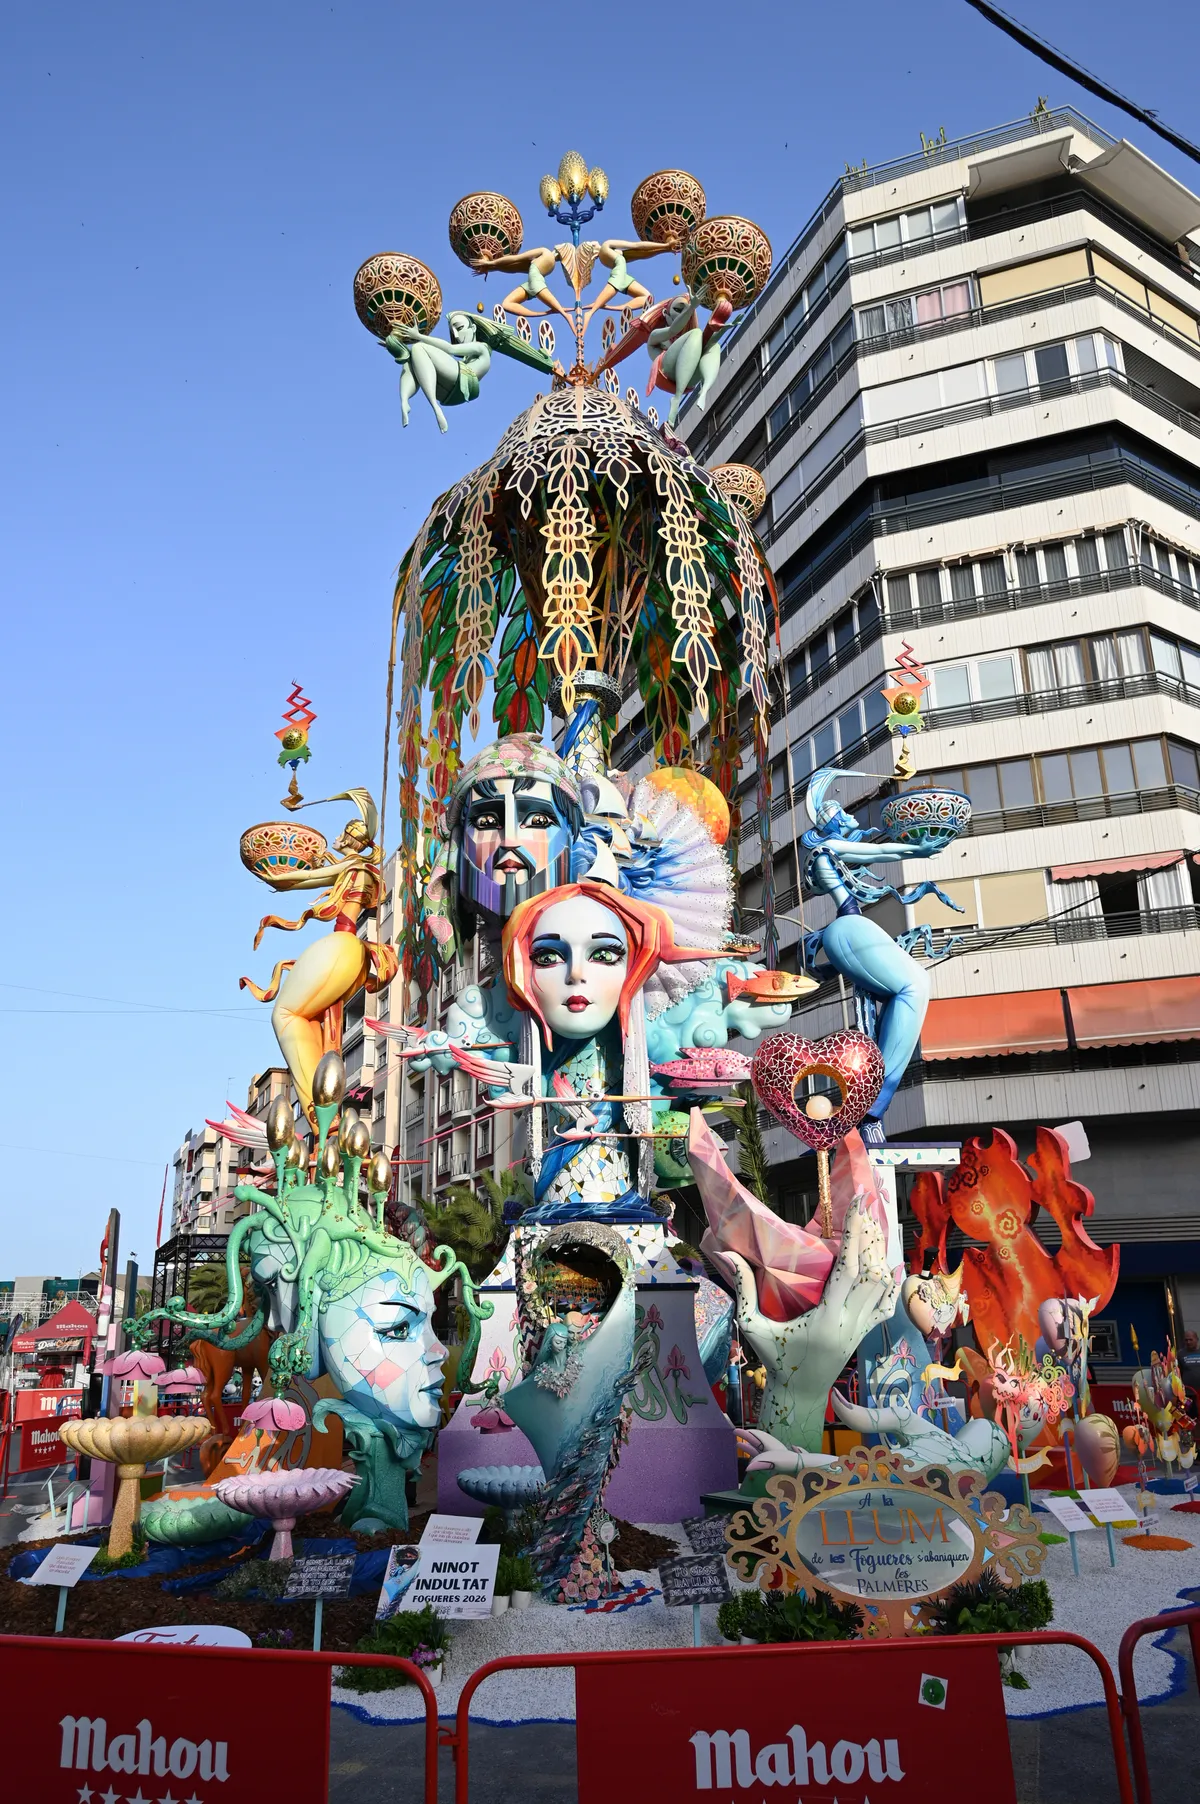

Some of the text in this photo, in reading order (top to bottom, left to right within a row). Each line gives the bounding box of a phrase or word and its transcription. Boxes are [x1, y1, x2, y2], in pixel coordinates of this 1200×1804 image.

[858, 1492, 895, 1510] A la
[817, 1507, 952, 1546] LLUM
[430, 1561, 480, 1573] NINOT
[811, 1546, 970, 1574] de les Fogueres s'abaniquen
[894, 1567, 911, 1580] les
[415, 1578, 489, 1590] INDULTAT
[412, 1595, 487, 1603] FOGUERES 2026
[58, 1714, 231, 1782] Mahou
[688, 1724, 906, 1789] Mahou
